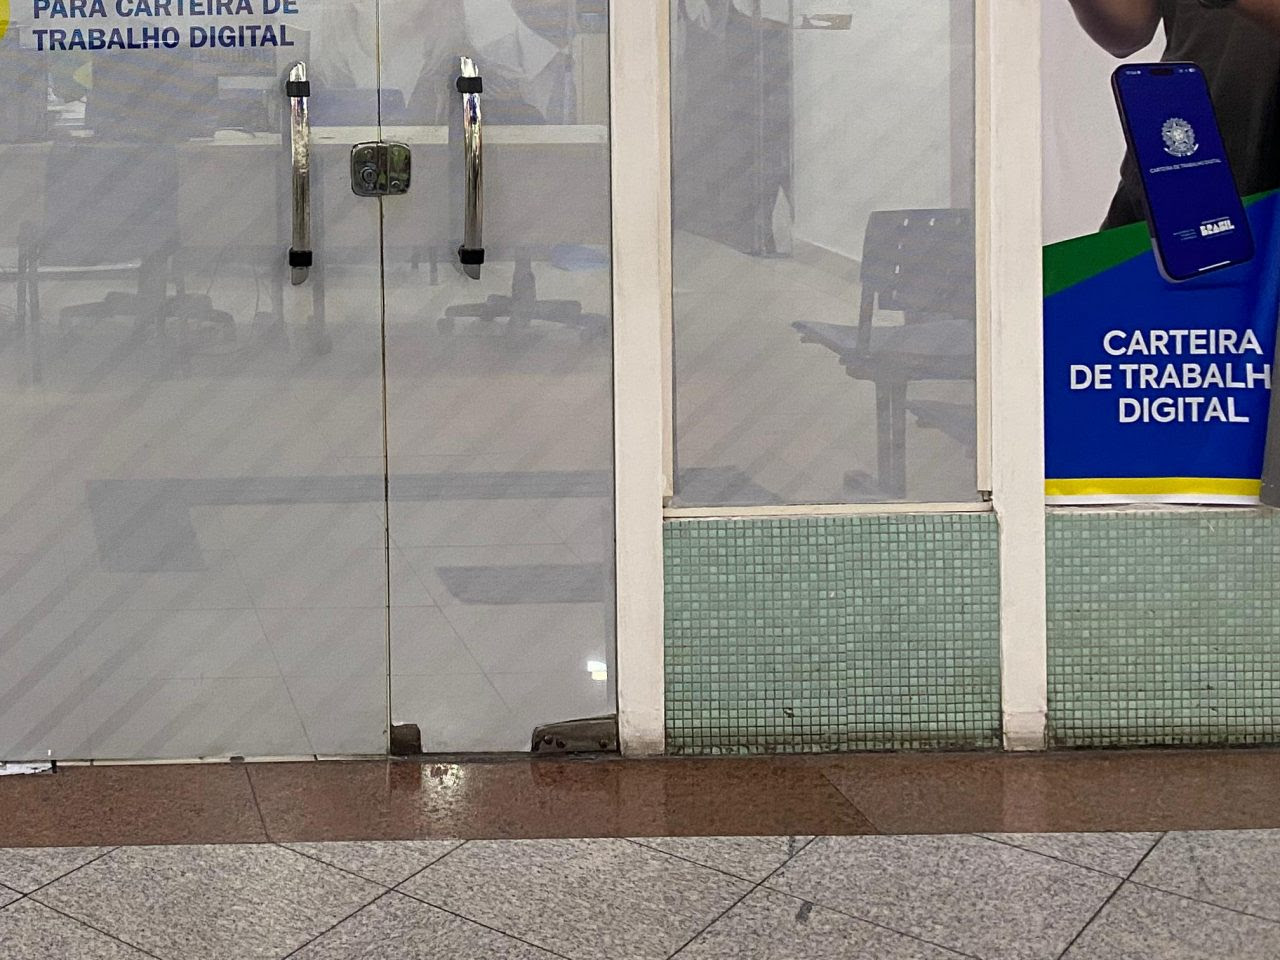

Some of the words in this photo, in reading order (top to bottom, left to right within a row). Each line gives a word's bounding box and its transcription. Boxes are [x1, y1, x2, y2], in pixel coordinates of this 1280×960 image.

[33, 26, 180, 51] TRABALHO
[189, 24, 295, 49] DIGITAL
[1103, 329, 1264, 356] CARTEIRA
[1070, 364, 1113, 390] DE
[1119, 362, 1272, 389] TRABALH
[1118, 397, 1250, 423] DIGITAL
